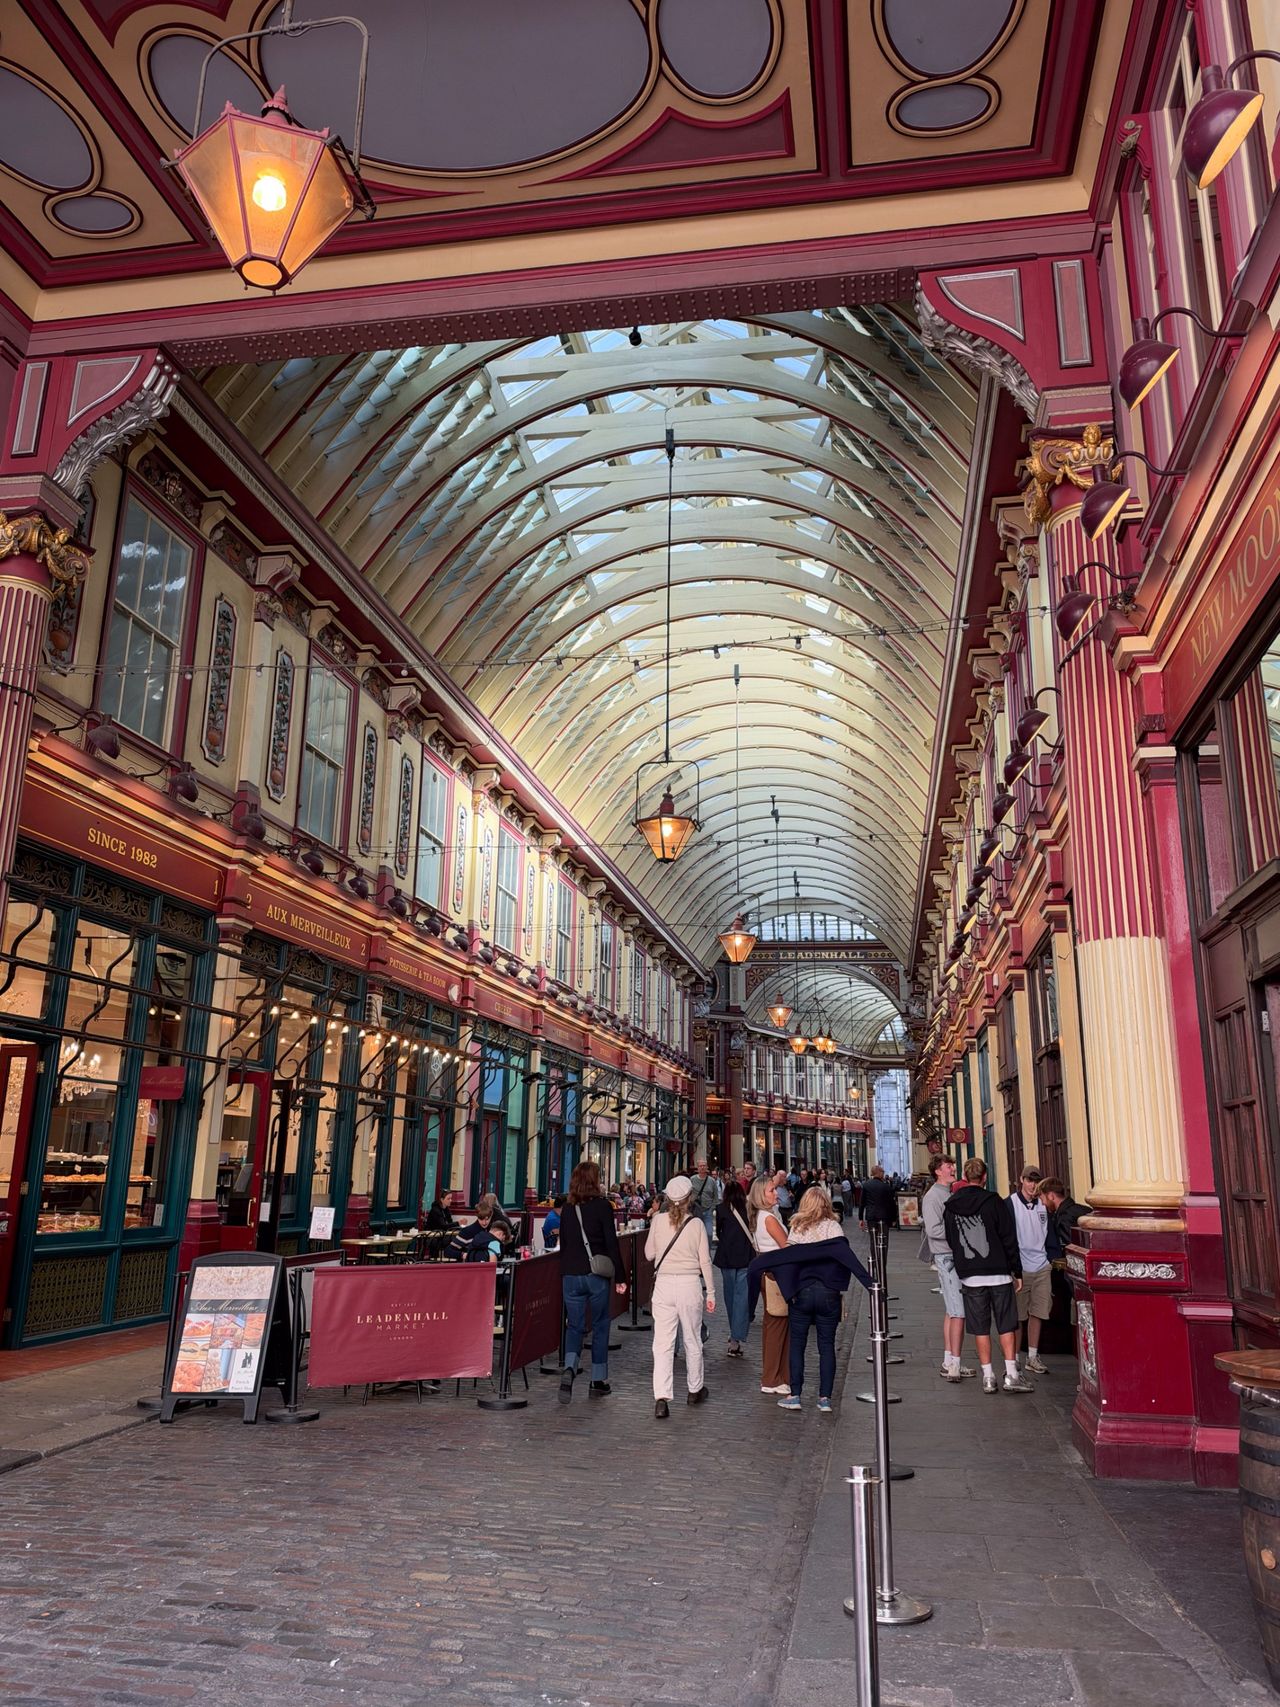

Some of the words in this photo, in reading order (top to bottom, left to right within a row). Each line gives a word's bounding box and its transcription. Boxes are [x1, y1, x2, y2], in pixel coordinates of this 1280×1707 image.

[1190, 583, 1225, 679] NEW
[88, 827, 127, 856] SINCE
[130, 846, 158, 869] 1982
[213, 880, 219, 895] 1
[246, 893, 252, 909] 2
[266, 904, 287, 924] AUX
[290, 913, 351, 950] MERVEILLEUX
[360, 943, 366, 956] 2
[779, 951, 865, 960] LEADENHALL
[388, 957, 418, 977] PATISSERIE
[418, 970, 423, 979] &
[423, 971, 433, 983] TEA
[432, 976, 446, 989] ROOM
[356, 1312, 449, 1324] LEADENHALL
[376, 1323, 425, 1331] MARKET
